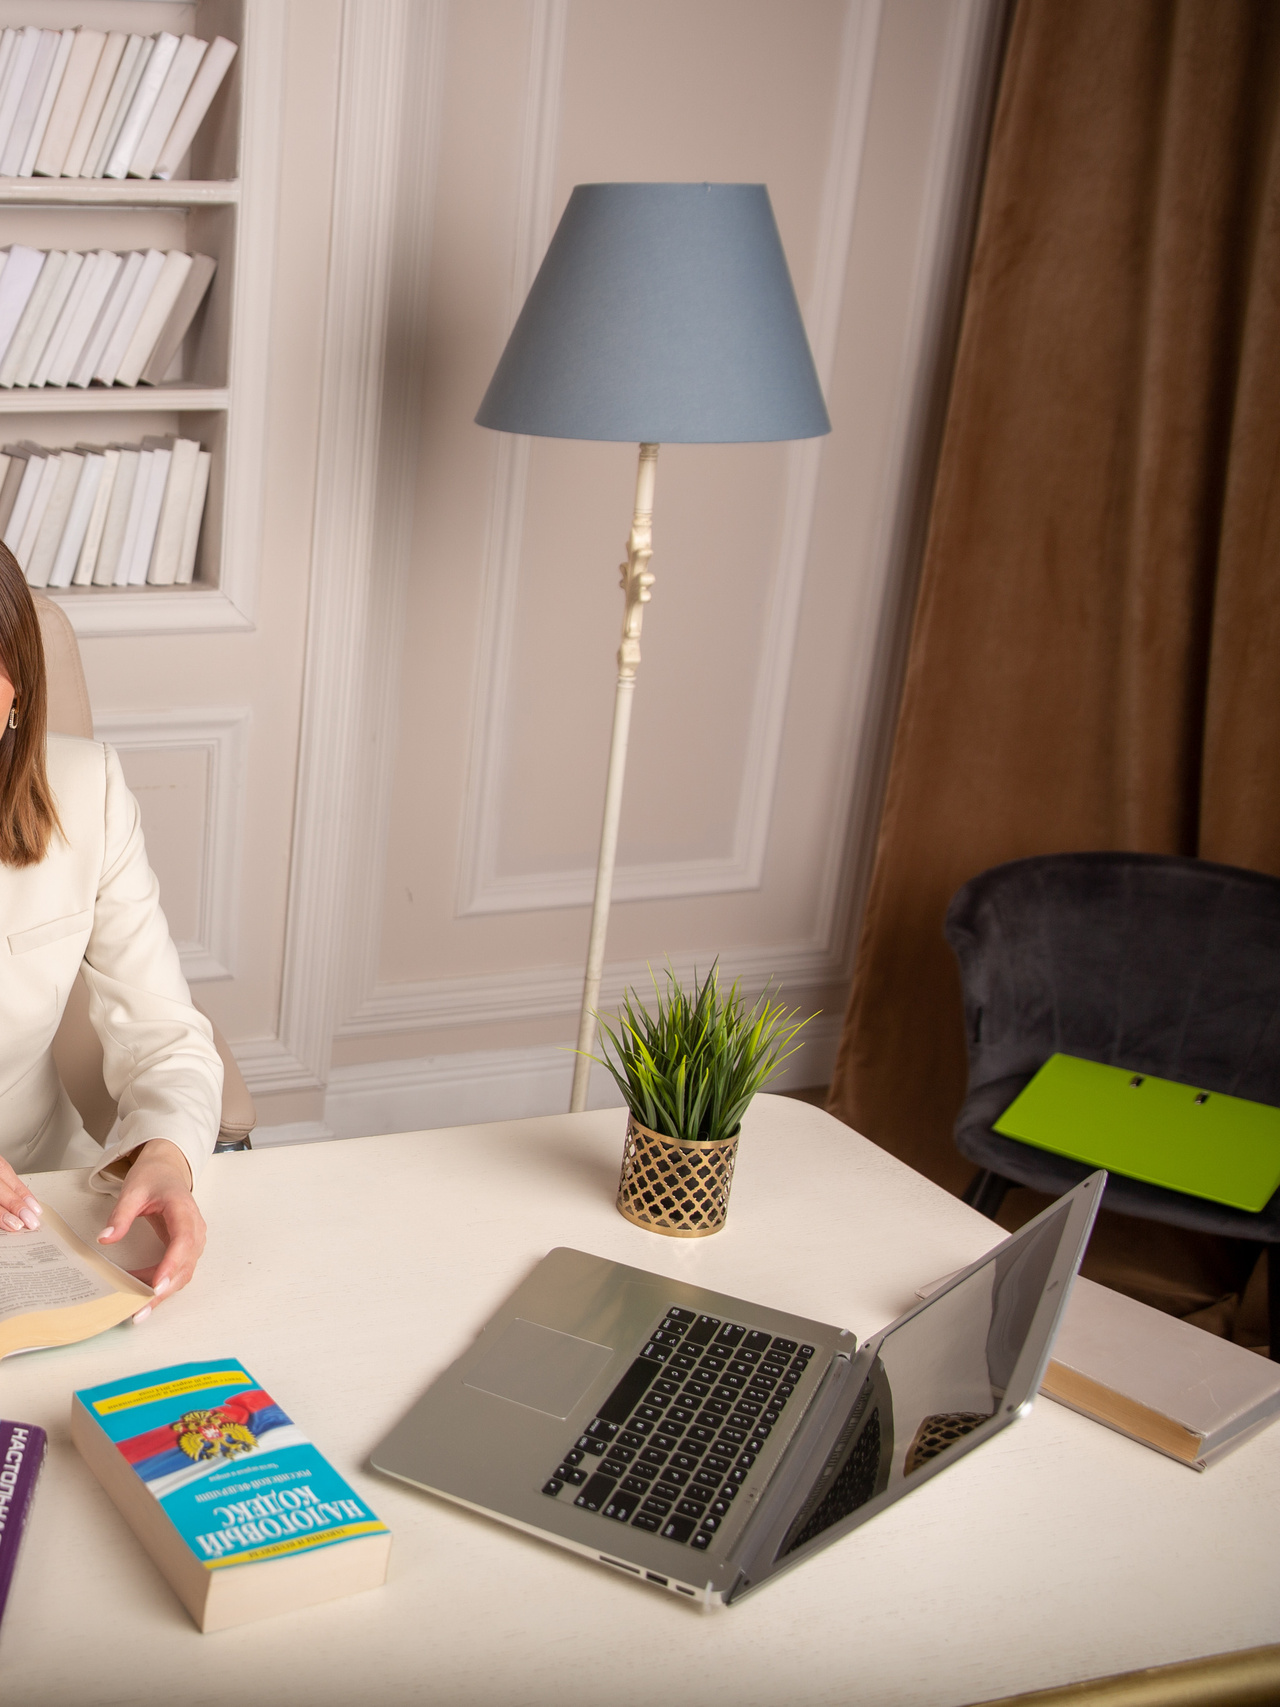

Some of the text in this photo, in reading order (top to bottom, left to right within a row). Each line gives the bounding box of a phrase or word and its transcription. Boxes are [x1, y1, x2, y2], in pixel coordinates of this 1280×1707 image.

[195, 1469, 312, 1503] РОССИЙСКОЙ ФЕДЕРАЦИИ
[213, 1485, 321, 1527] КОДЕКС
[196, 1500, 366, 1557] НАЛОГОВЫЙ
